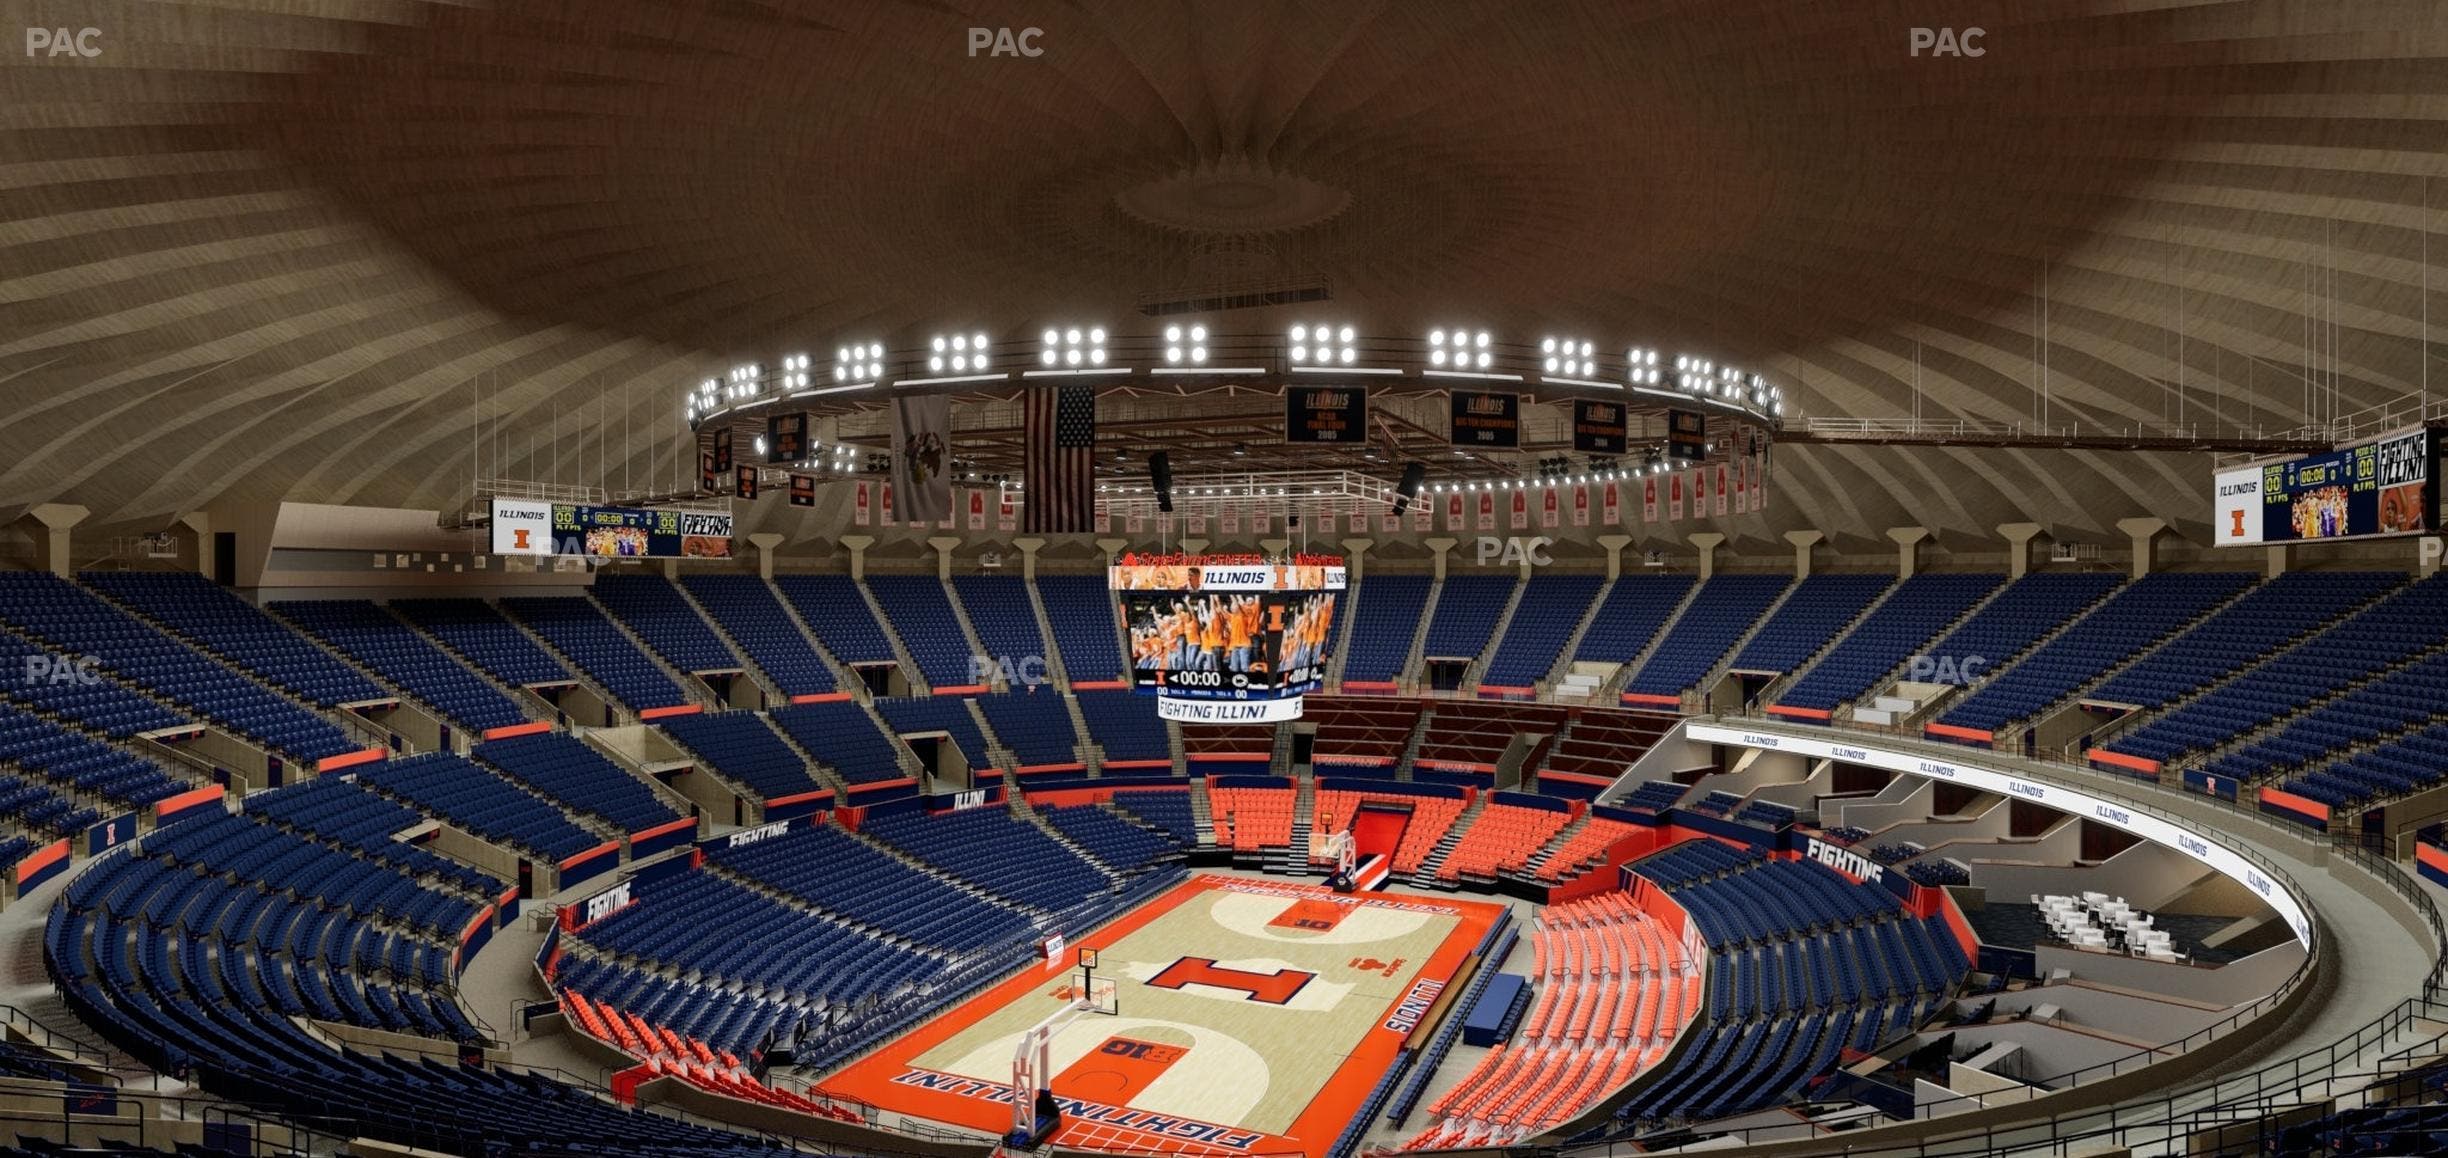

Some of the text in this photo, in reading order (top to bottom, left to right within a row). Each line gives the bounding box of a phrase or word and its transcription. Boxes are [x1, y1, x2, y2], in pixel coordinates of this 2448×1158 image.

[1306, 391, 1349, 408] ILLINOIS
[2301, 468, 2325, 483] 00:00
[2359, 458, 2374, 477] 00
[2220, 481, 2257, 497] ILLINOIS
[2266, 476, 2280, 492] 00
[499, 509, 545, 520] ILLINOIS
[556, 512, 572, 523] 00
[597, 514, 623, 523] 00:00
[684, 514, 732, 526] FIGHTING
[661, 518, 677, 528] 00
[1204, 573, 1265, 584] ILLINOIS
[1180, 671, 1221, 686] 00:00
[1157, 687, 1168, 696] 00
[1235, 690, 1247, 699] 00
[1160, 702, 1267, 719] FIGHTING ILLINI
[1743, 735, 1778, 747] ILLINOIS
[1832, 747, 1866, 760] ILLINOIS
[1920, 762, 1954, 777] ILLINOIS
[2009, 781, 2044, 798] ILLINOIS
[954, 790, 986, 810] ILLINI
[2096, 805, 2129, 825] ILLINOIS
[729, 821, 789, 848] FIGHTING
[2178, 834, 2207, 857] ILLINOIS
[1807, 838, 1884, 883] FIGHTING
[2247, 869, 2271, 896] ILLINOIS
[587, 882, 631, 922] FIGHTING
[1385, 978, 1444, 1033] ILLINOIS
